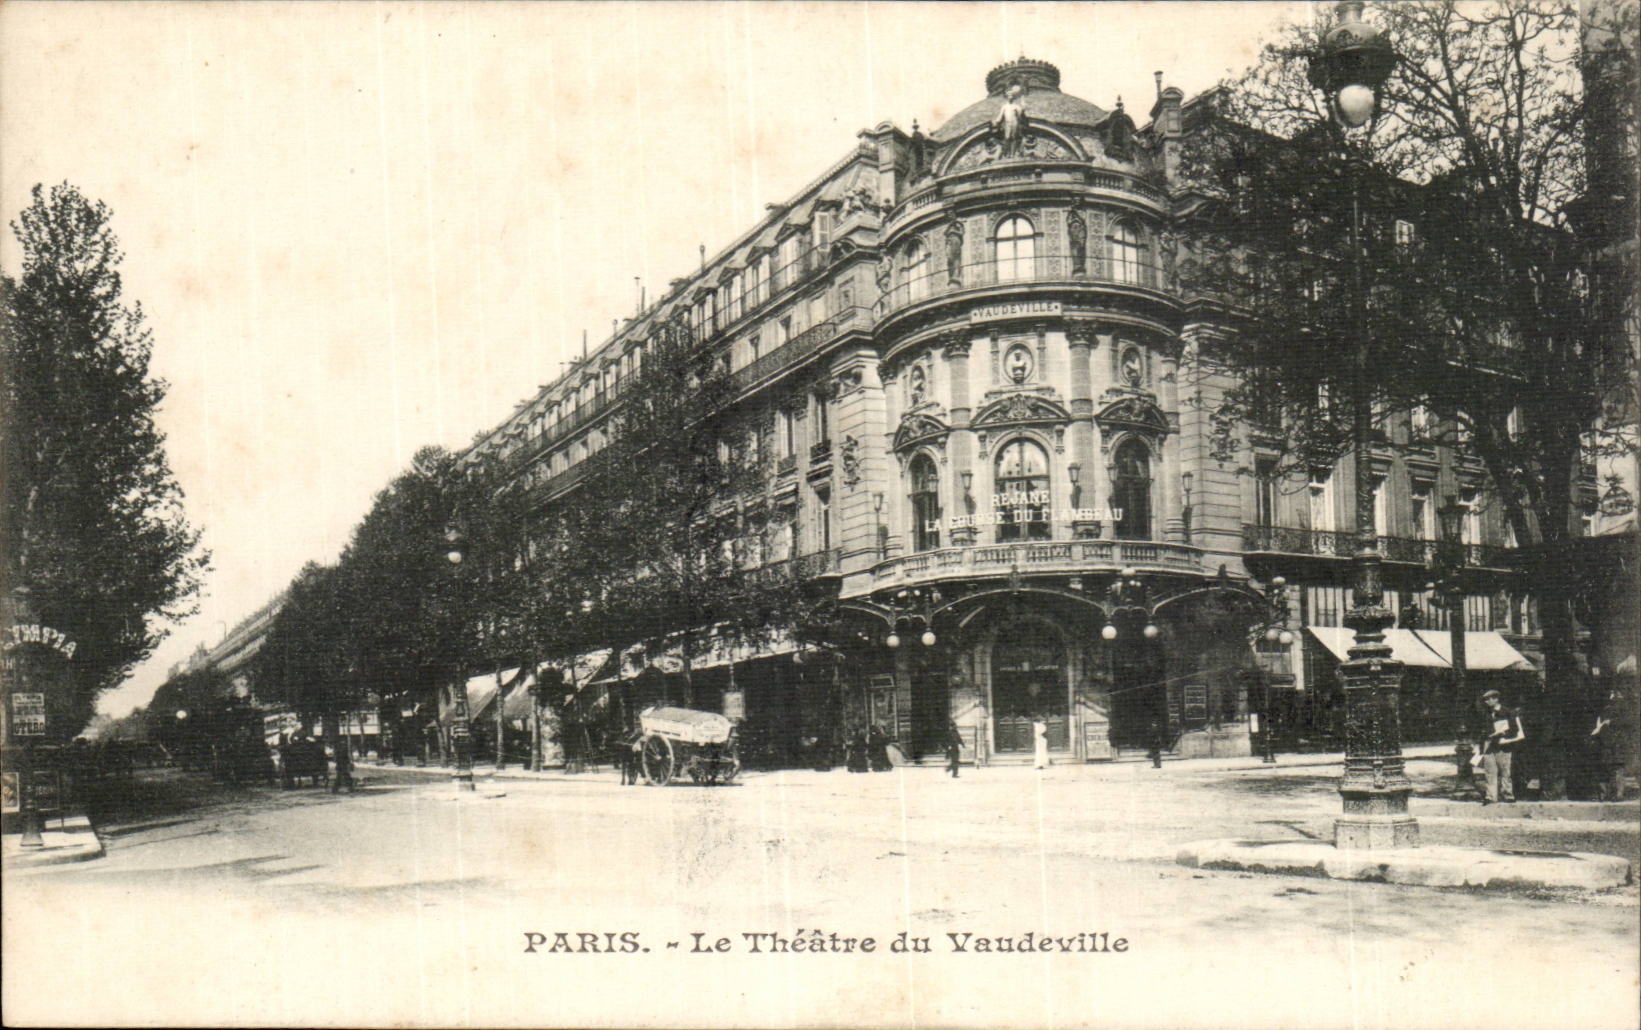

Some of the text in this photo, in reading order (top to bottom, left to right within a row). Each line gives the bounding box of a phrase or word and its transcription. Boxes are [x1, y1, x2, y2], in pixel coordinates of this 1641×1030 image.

[980, 303, 1053, 317] VAUDEVILLE
[925, 518, 941, 532] LA
[1013, 509, 1033, 523] DU
